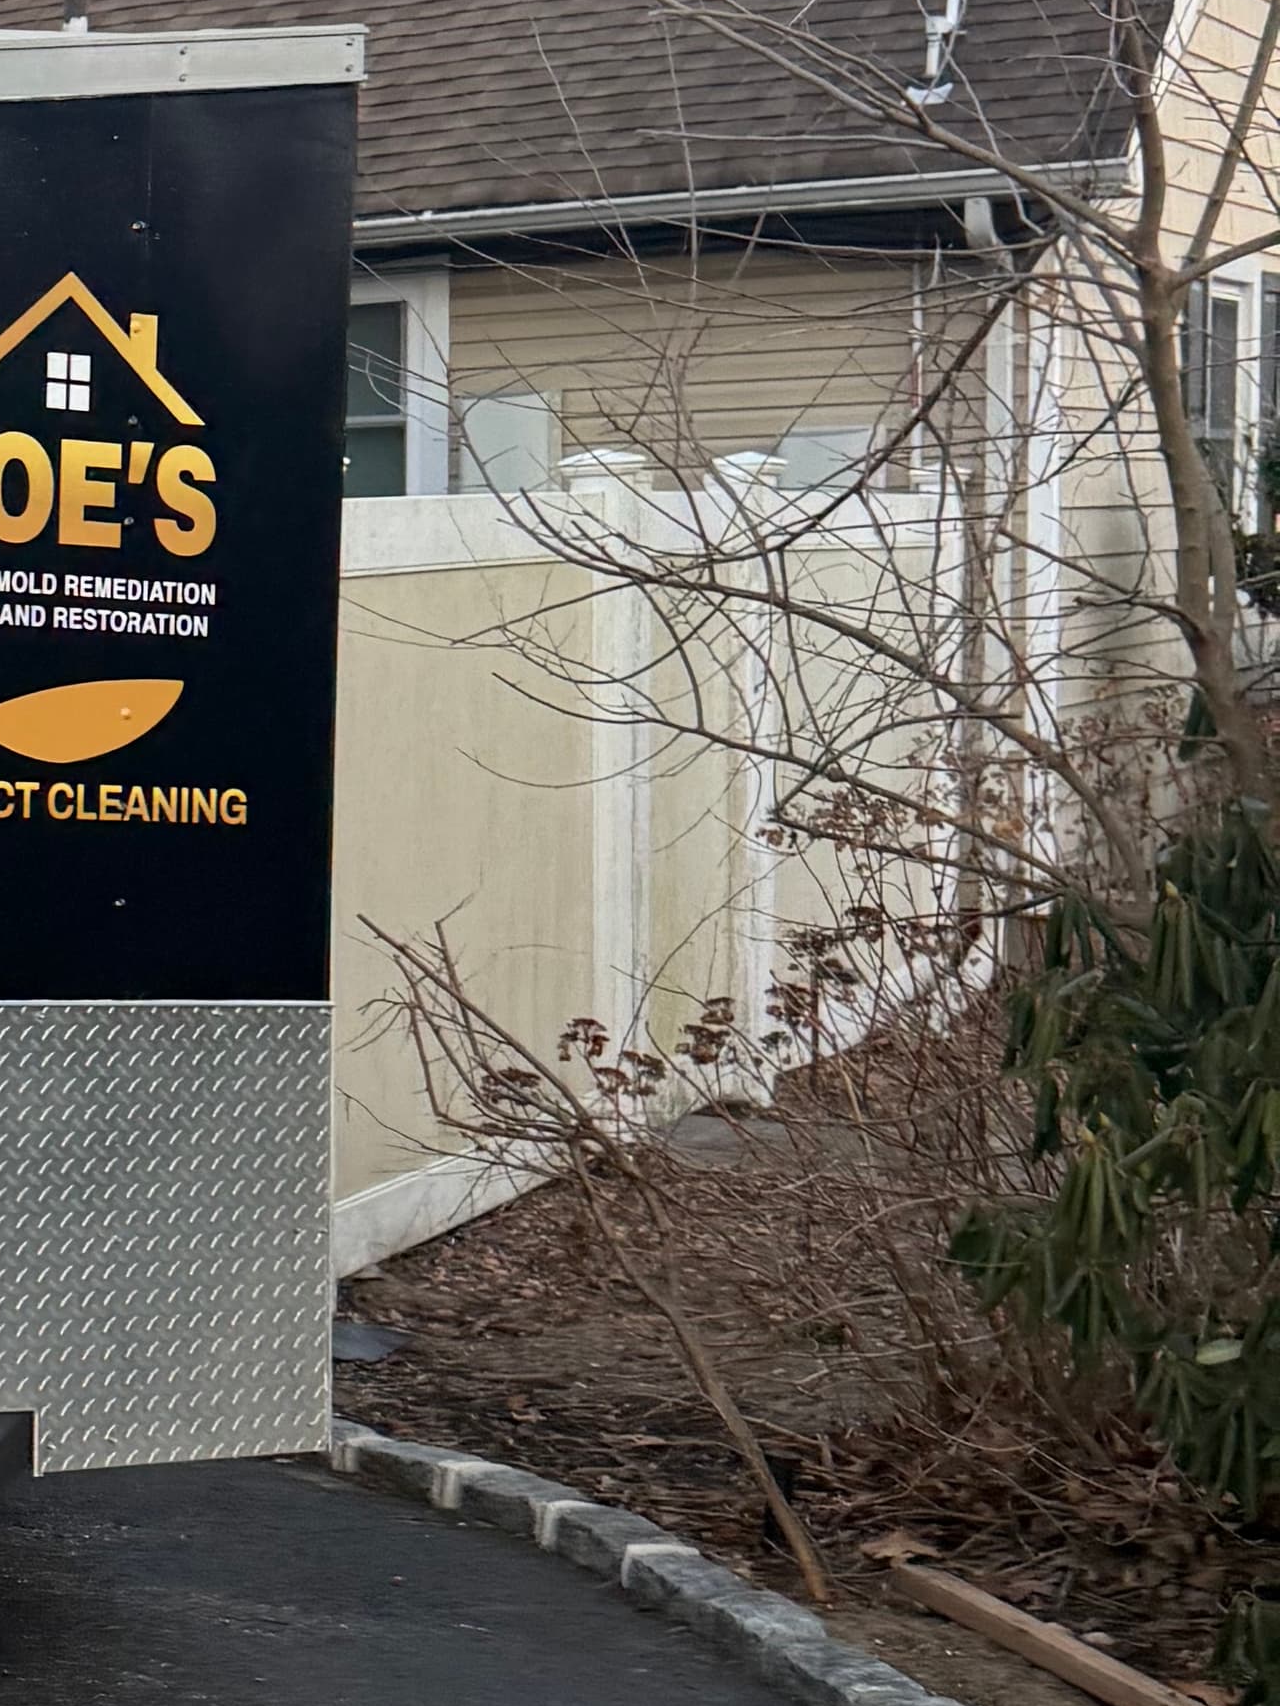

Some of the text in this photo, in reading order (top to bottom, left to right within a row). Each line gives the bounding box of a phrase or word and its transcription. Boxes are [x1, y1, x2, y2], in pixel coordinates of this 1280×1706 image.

[65, 574, 216, 606] REMEDIATION
[53, 607, 209, 638] RESTORATION
[47, 782, 248, 825] CLEANING
